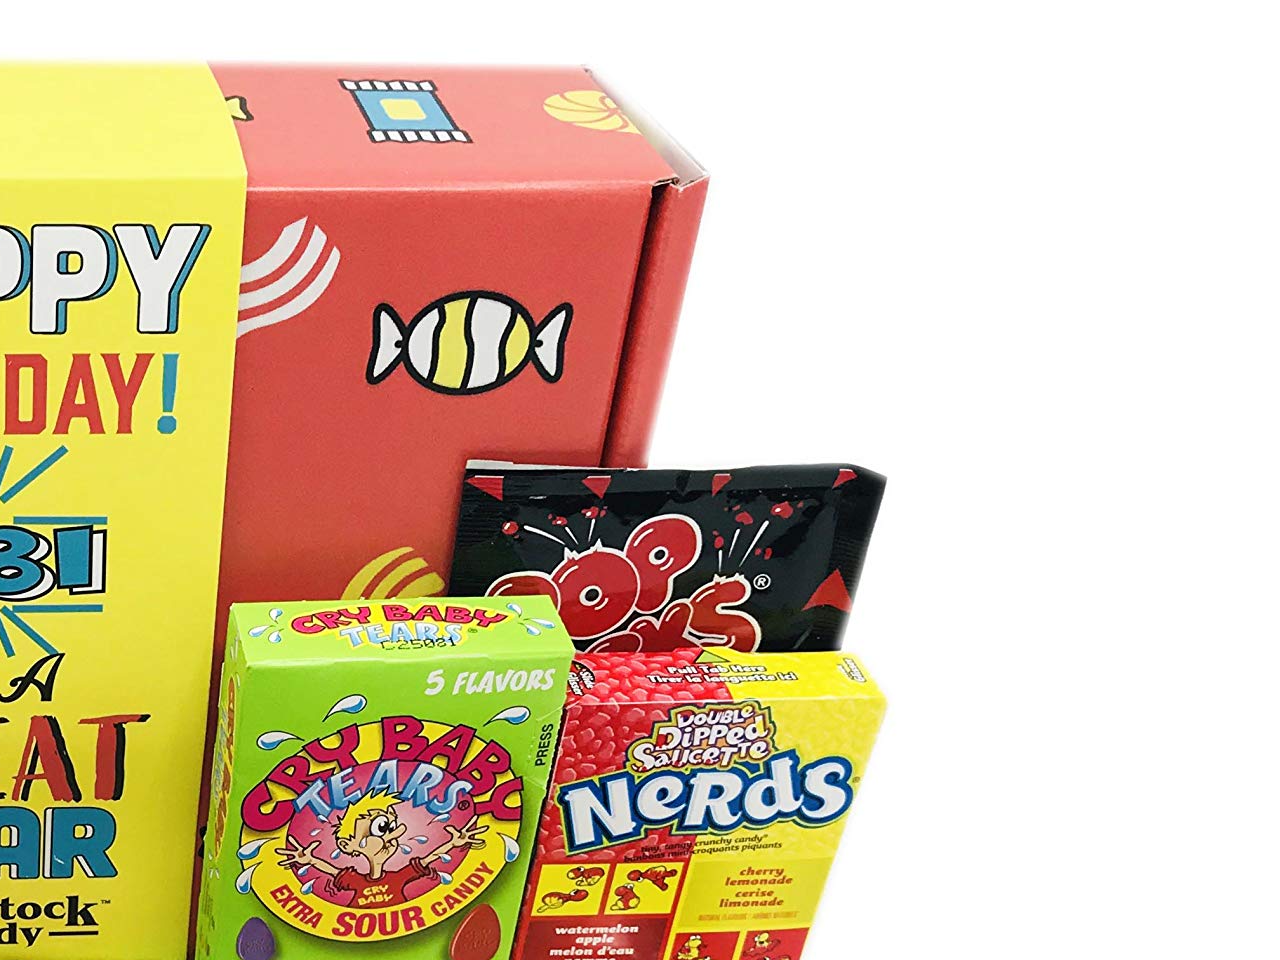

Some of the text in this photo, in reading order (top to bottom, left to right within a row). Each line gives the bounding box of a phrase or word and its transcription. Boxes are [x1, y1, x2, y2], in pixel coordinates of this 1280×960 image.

[290, 603, 509, 636] CRY BABY
[339, 622, 463, 649] TEARS
[667, 663, 767, 675] Pull Tab Here
[424, 667, 556, 697] 5 FLAVORS
[647, 673, 683, 685] Tirer
[685, 672, 702, 684] la
[704, 671, 778, 686] languette
[534, 723, 554, 767] PRESS
[241, 722, 361, 832] CRY
[380, 715, 524, 821] BABY
[292, 757, 474, 820] TEARS
[694, 837, 733, 847] crunchy
[741, 841, 783, 852] piquants
[739, 866, 785, 877] cherry
[725, 876, 793, 887] lemonade
[362, 884, 390, 897] CRY
[735, 888, 775, 898] cerise
[269, 861, 495, 938] EXTRA SOUR CANDY
[357, 893, 394, 906] BABY
[719, 898, 785, 909] limonade
[555, 923, 639, 935] watermelon
[575, 934, 615, 946] apple
[549, 945, 635, 956] melon d'eau
